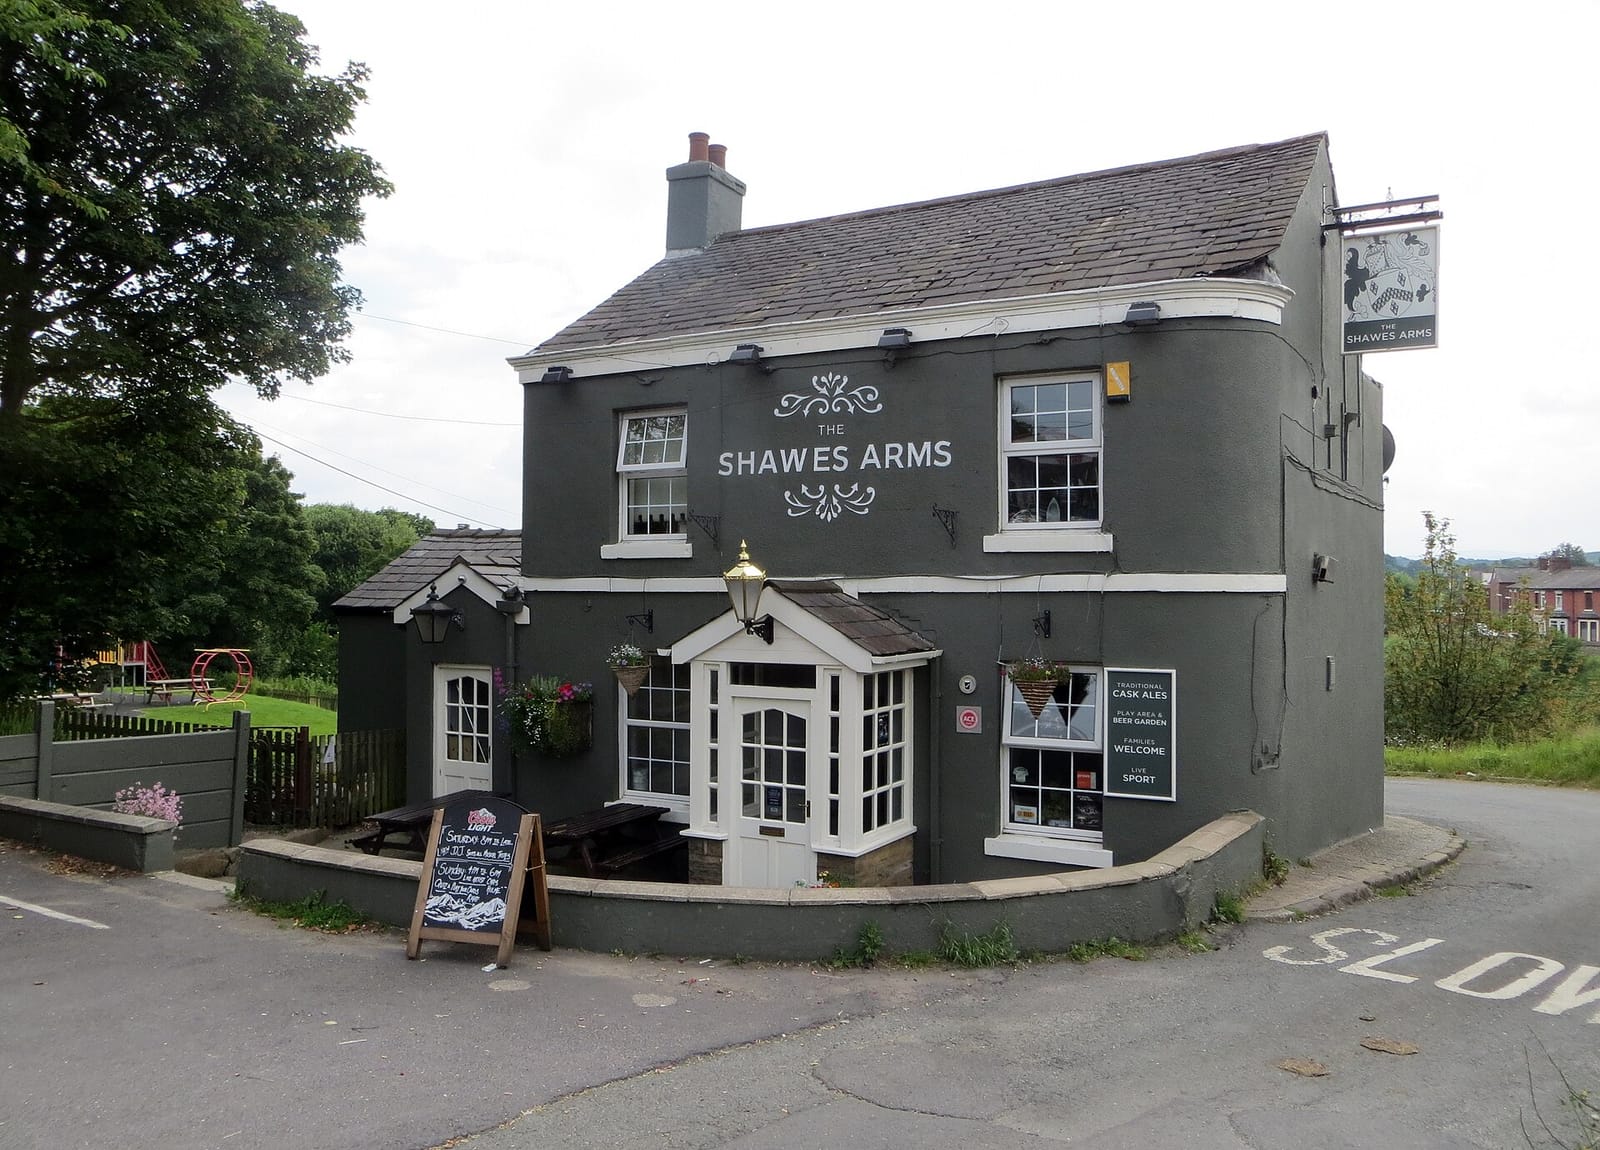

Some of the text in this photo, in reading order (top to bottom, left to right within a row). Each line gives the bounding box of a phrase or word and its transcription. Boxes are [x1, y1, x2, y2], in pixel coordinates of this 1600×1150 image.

[1347, 328, 1432, 344] SHAWES ARMS
[818, 424, 845, 436] THE
[718, 440, 952, 476] SHAWES ARMS
[1117, 682, 1163, 690] TRADITIONAL
[1112, 689, 1168, 700] CASK ALES
[1112, 717, 1167, 726] BEER GARDEN
[1123, 737, 1155, 745] FAMILIES
[1114, 745, 1166, 756] WELCOME
[1122, 774, 1156, 784] SPORT
[467, 824, 494, 832] LIGHT
